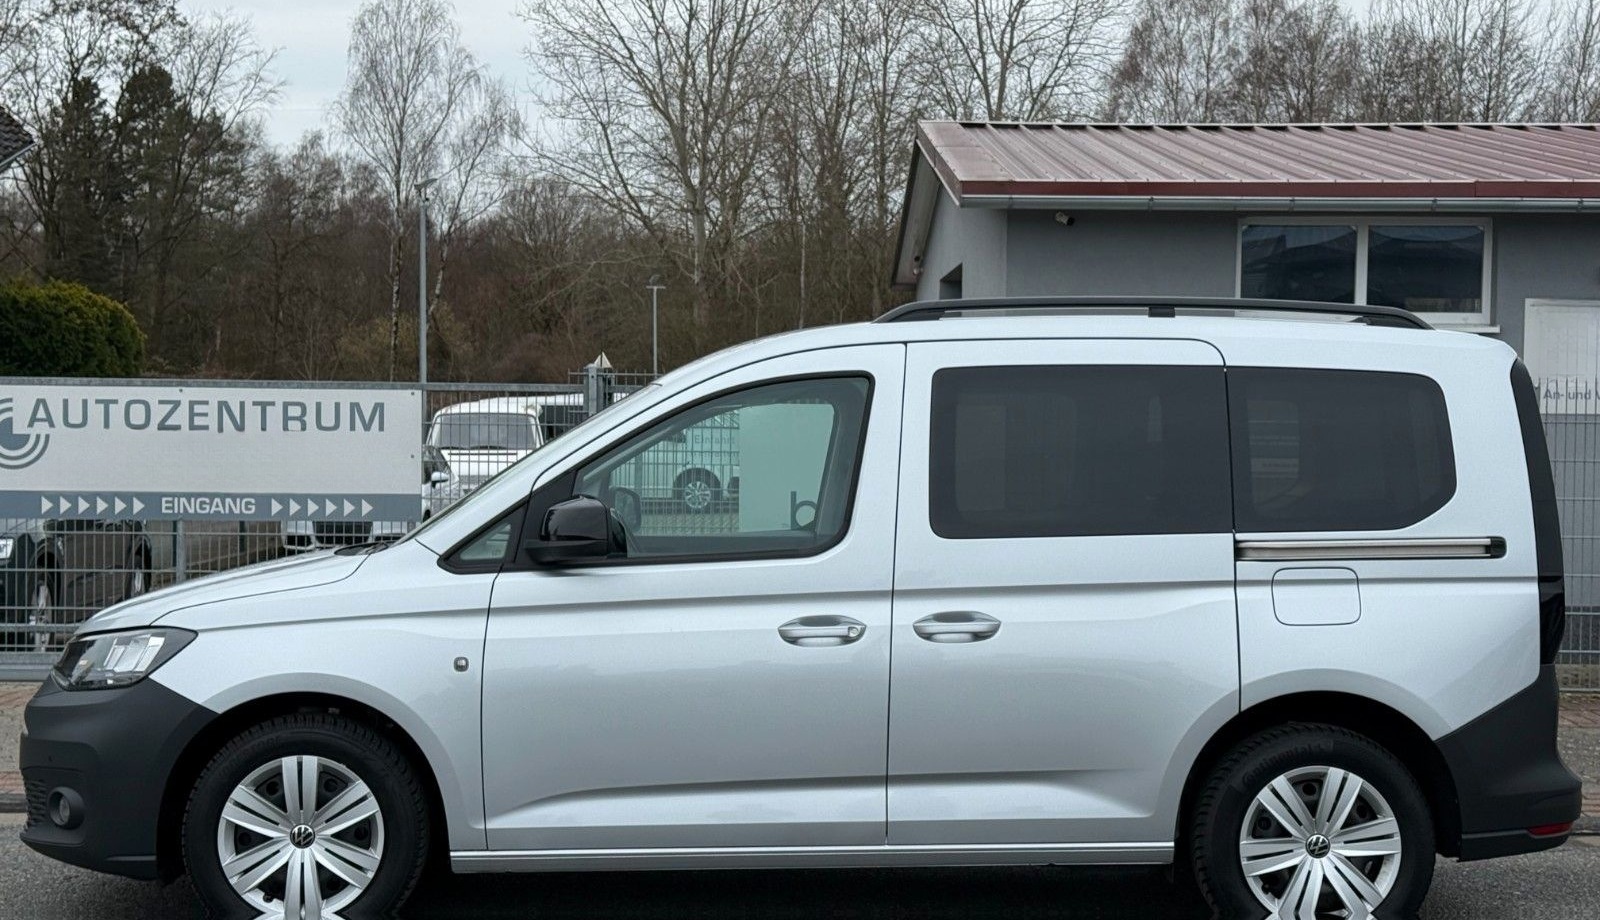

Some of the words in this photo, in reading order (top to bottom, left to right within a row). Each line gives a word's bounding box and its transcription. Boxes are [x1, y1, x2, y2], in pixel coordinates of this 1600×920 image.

[1567, 388, 1591, 400] und
[27, 398, 385, 433] AUTOZENTRUM
[161, 497, 256, 515] EINGANG
